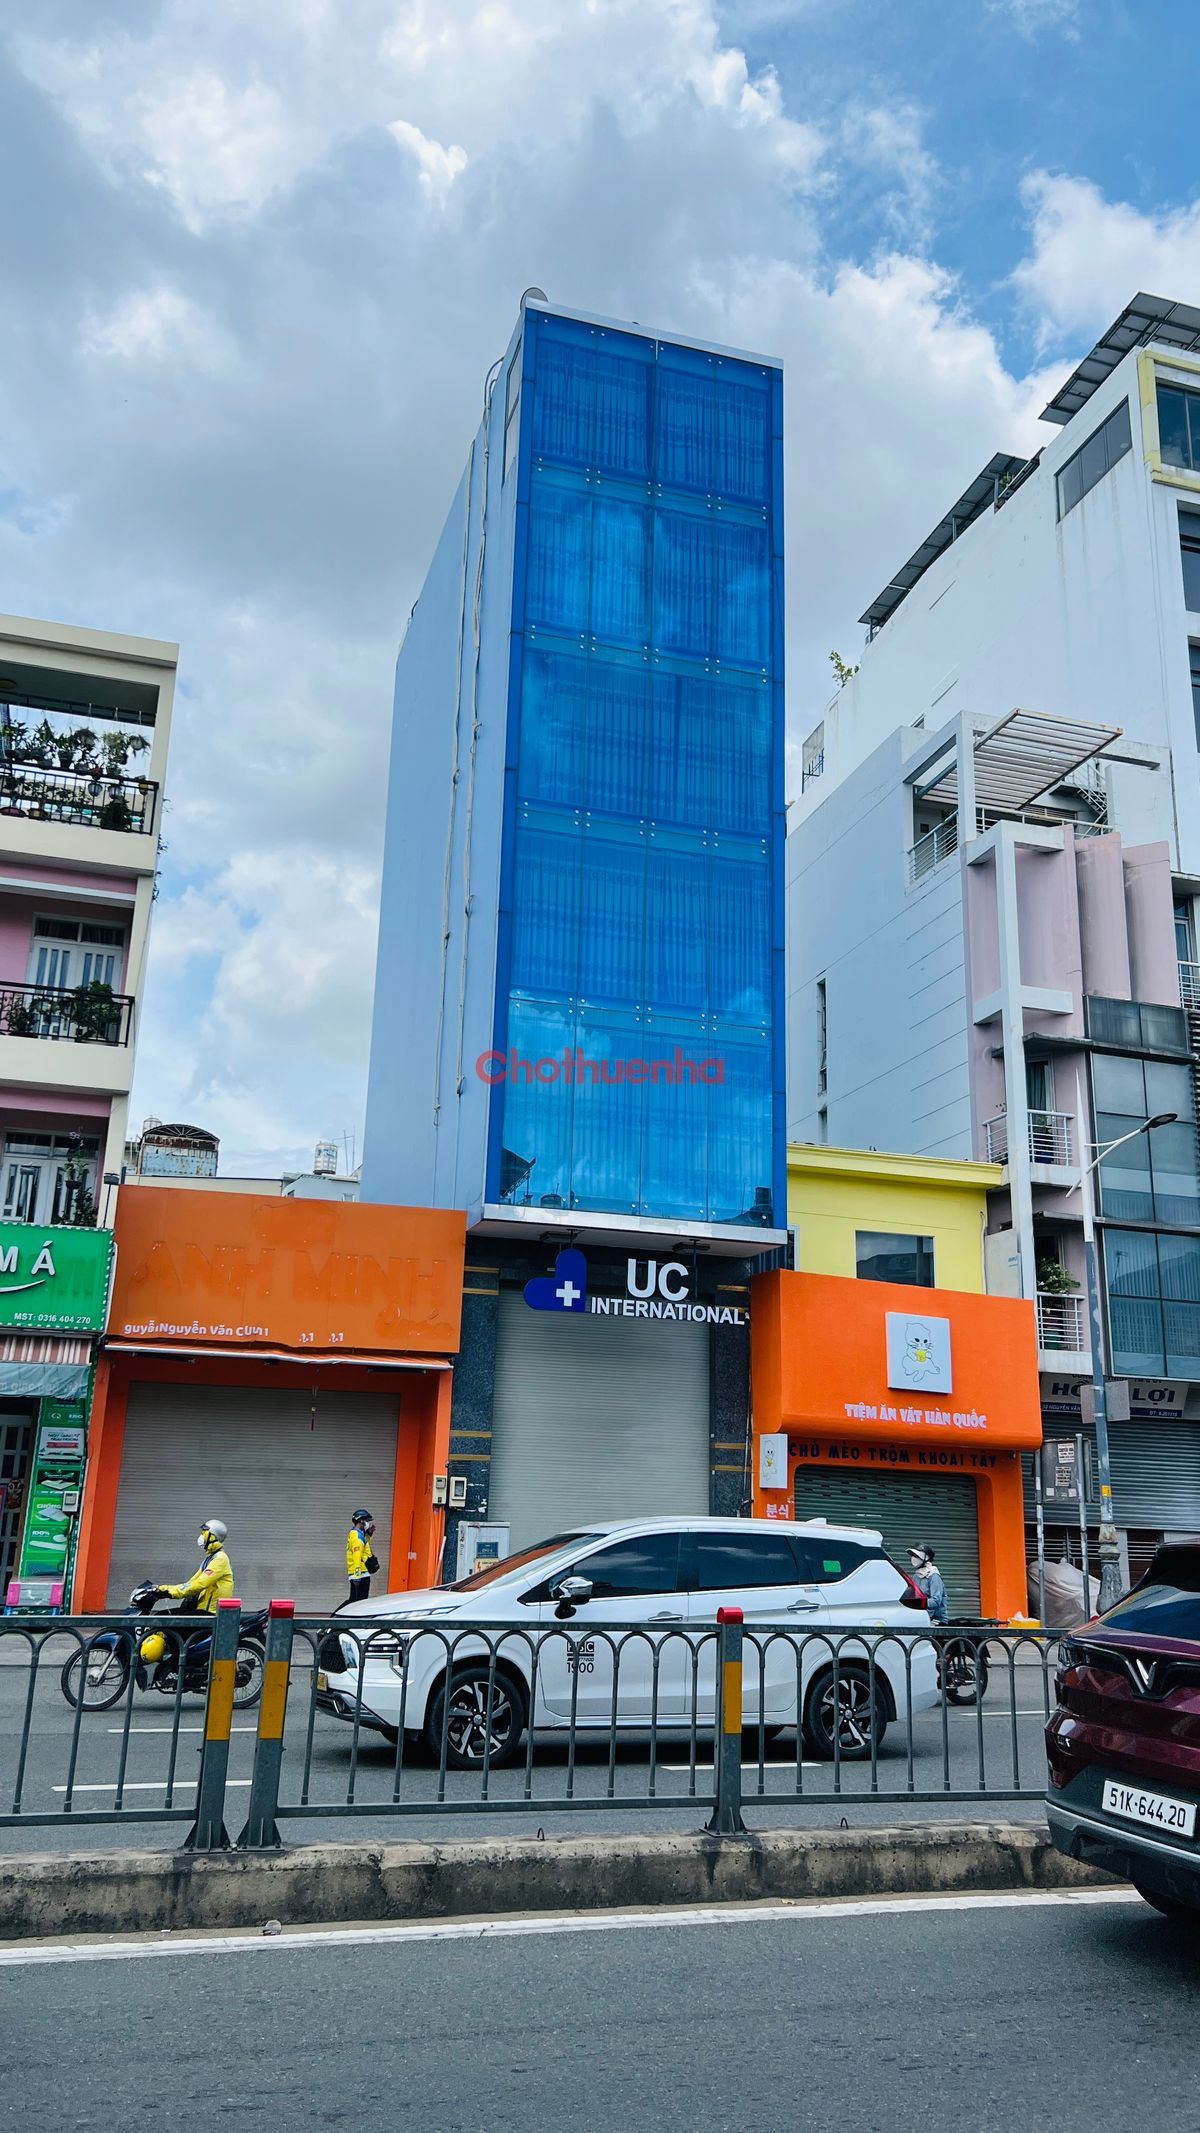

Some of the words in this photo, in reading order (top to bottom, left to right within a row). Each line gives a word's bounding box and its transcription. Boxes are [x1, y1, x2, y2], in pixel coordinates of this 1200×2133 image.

[31, 1240, 56, 1276] Á
[627, 1258, 690, 1301] UC
[14, 1312, 36, 1321] MST:
[38, 1313, 57, 1322] 0316
[59, 1315, 74, 1323] 404
[76, 1316, 91, 1324] 270
[591, 1296, 745, 1326] INTERNATIONAL
[1132, 1387, 1175, 1405] LỢI
[845, 1402, 877, 1421] TIỆM
[880, 1404, 897, 1421] ĂN
[900, 1406, 922, 1425] VẶT
[924, 1407, 951, 1425] HÀN
[953, 1408, 987, 1428] QUỐC
[789, 1440, 820, 1457] CHÚ
[828, 1440, 860, 1460] MÈO
[868, 1444, 910, 1466] TRỘM
[919, 1451, 965, 1467] KHOAI
[971, 1450, 997, 1468] TÂY
